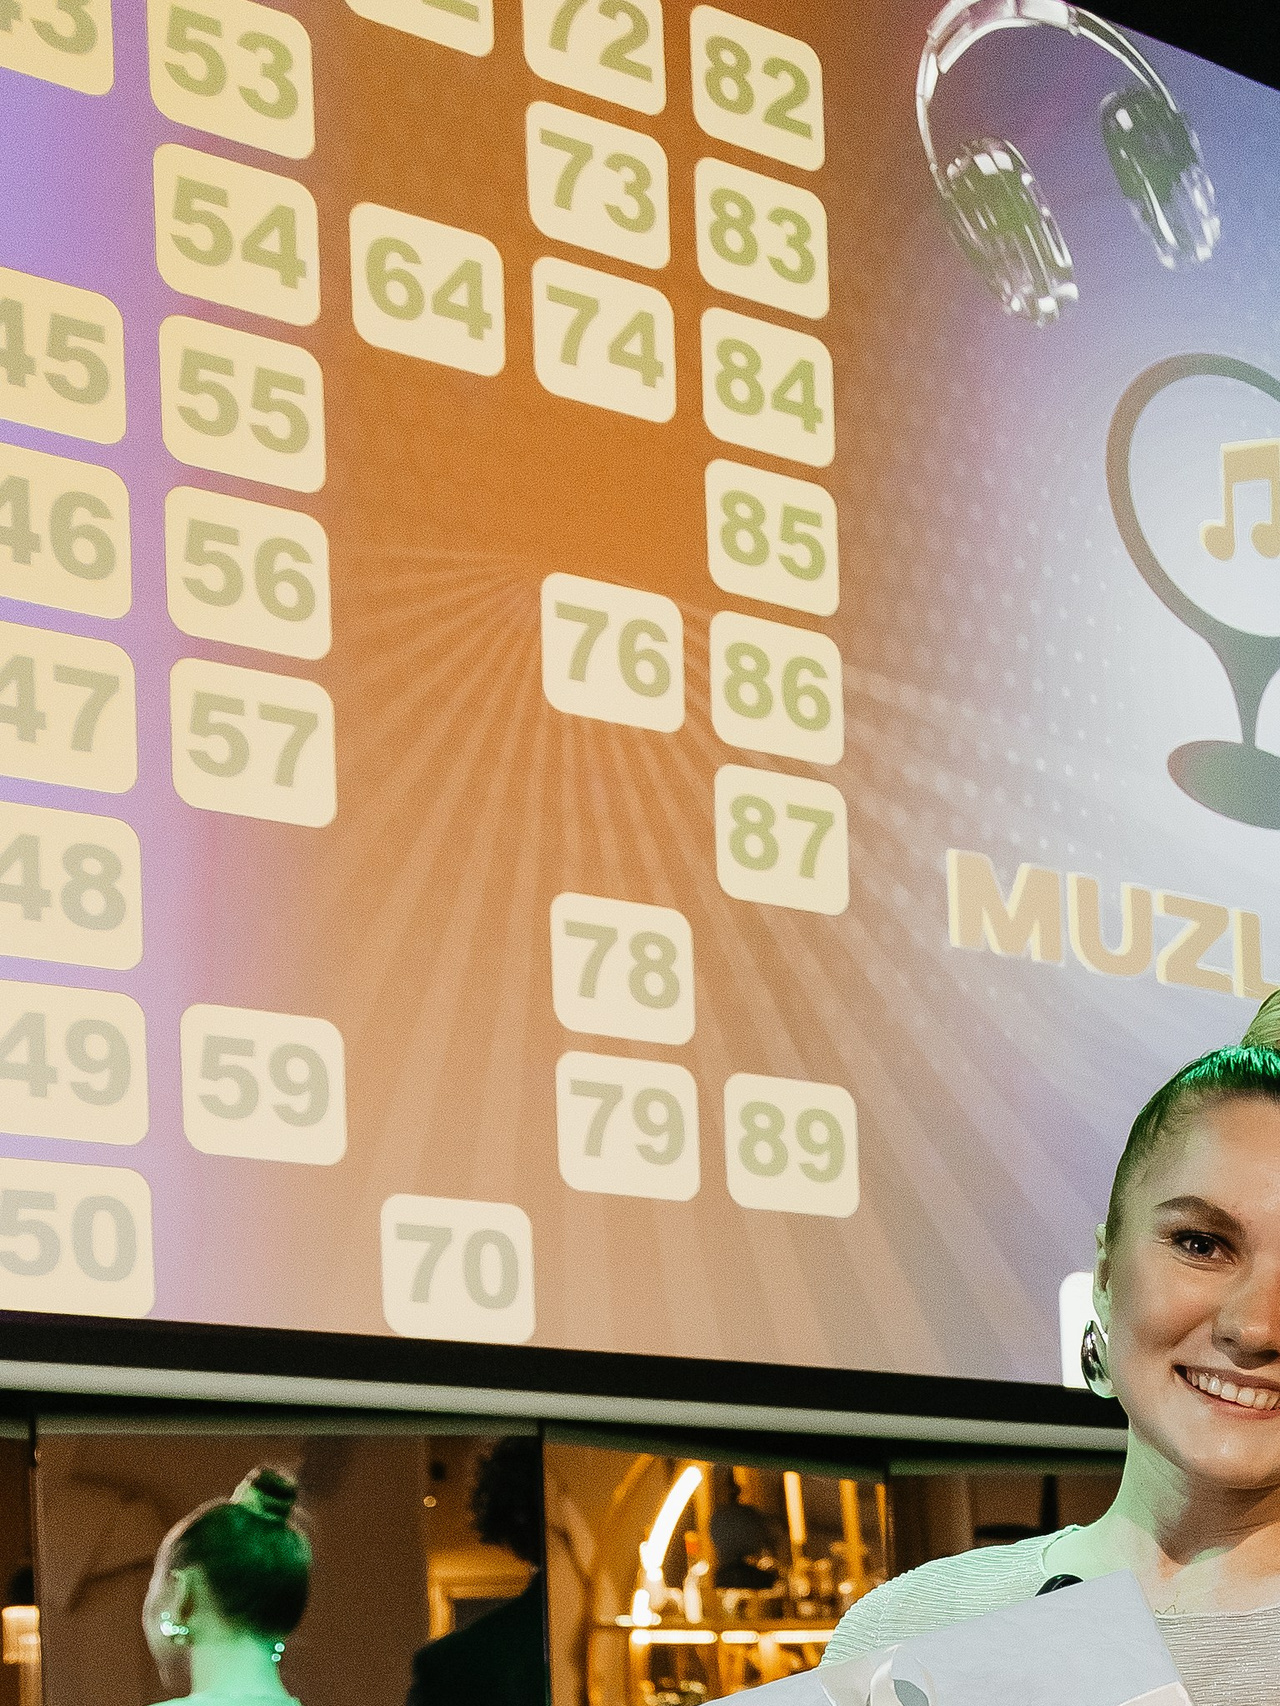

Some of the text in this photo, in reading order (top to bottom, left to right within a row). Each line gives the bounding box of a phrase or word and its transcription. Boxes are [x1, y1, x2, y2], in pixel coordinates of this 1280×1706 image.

[0, 0, 97, 54] 3
[163, 3, 299, 121] 53
[703, 35, 814, 141] 82
[539, 128, 656, 235] 73
[170, 174, 308, 289] 54
[708, 186, 817, 285] 83
[364, 236, 493, 341] 64
[545, 285, 665, 389] 74
[177, 347, 311, 455] 55
[714, 338, 824, 434] 84
[184, 519, 315, 621] 56
[721, 491, 826, 581] 85
[556, 602, 671, 698] 76
[725, 642, 831, 731] 86
[0, 655, 119, 752] 47
[189, 692, 318, 787] 57
[0, 834, 126, 930] 48
[730, 795, 834, 878] 87
[565, 921, 680, 1009] 78
[0, 1012, 131, 1105] 49
[200, 1035, 329, 1126] 59
[571, 1080, 685, 1165] 79
[739, 1102, 845, 1182] 89
[0, 1189, 137, 1282] 50
[396, 1223, 519, 1309] 70
